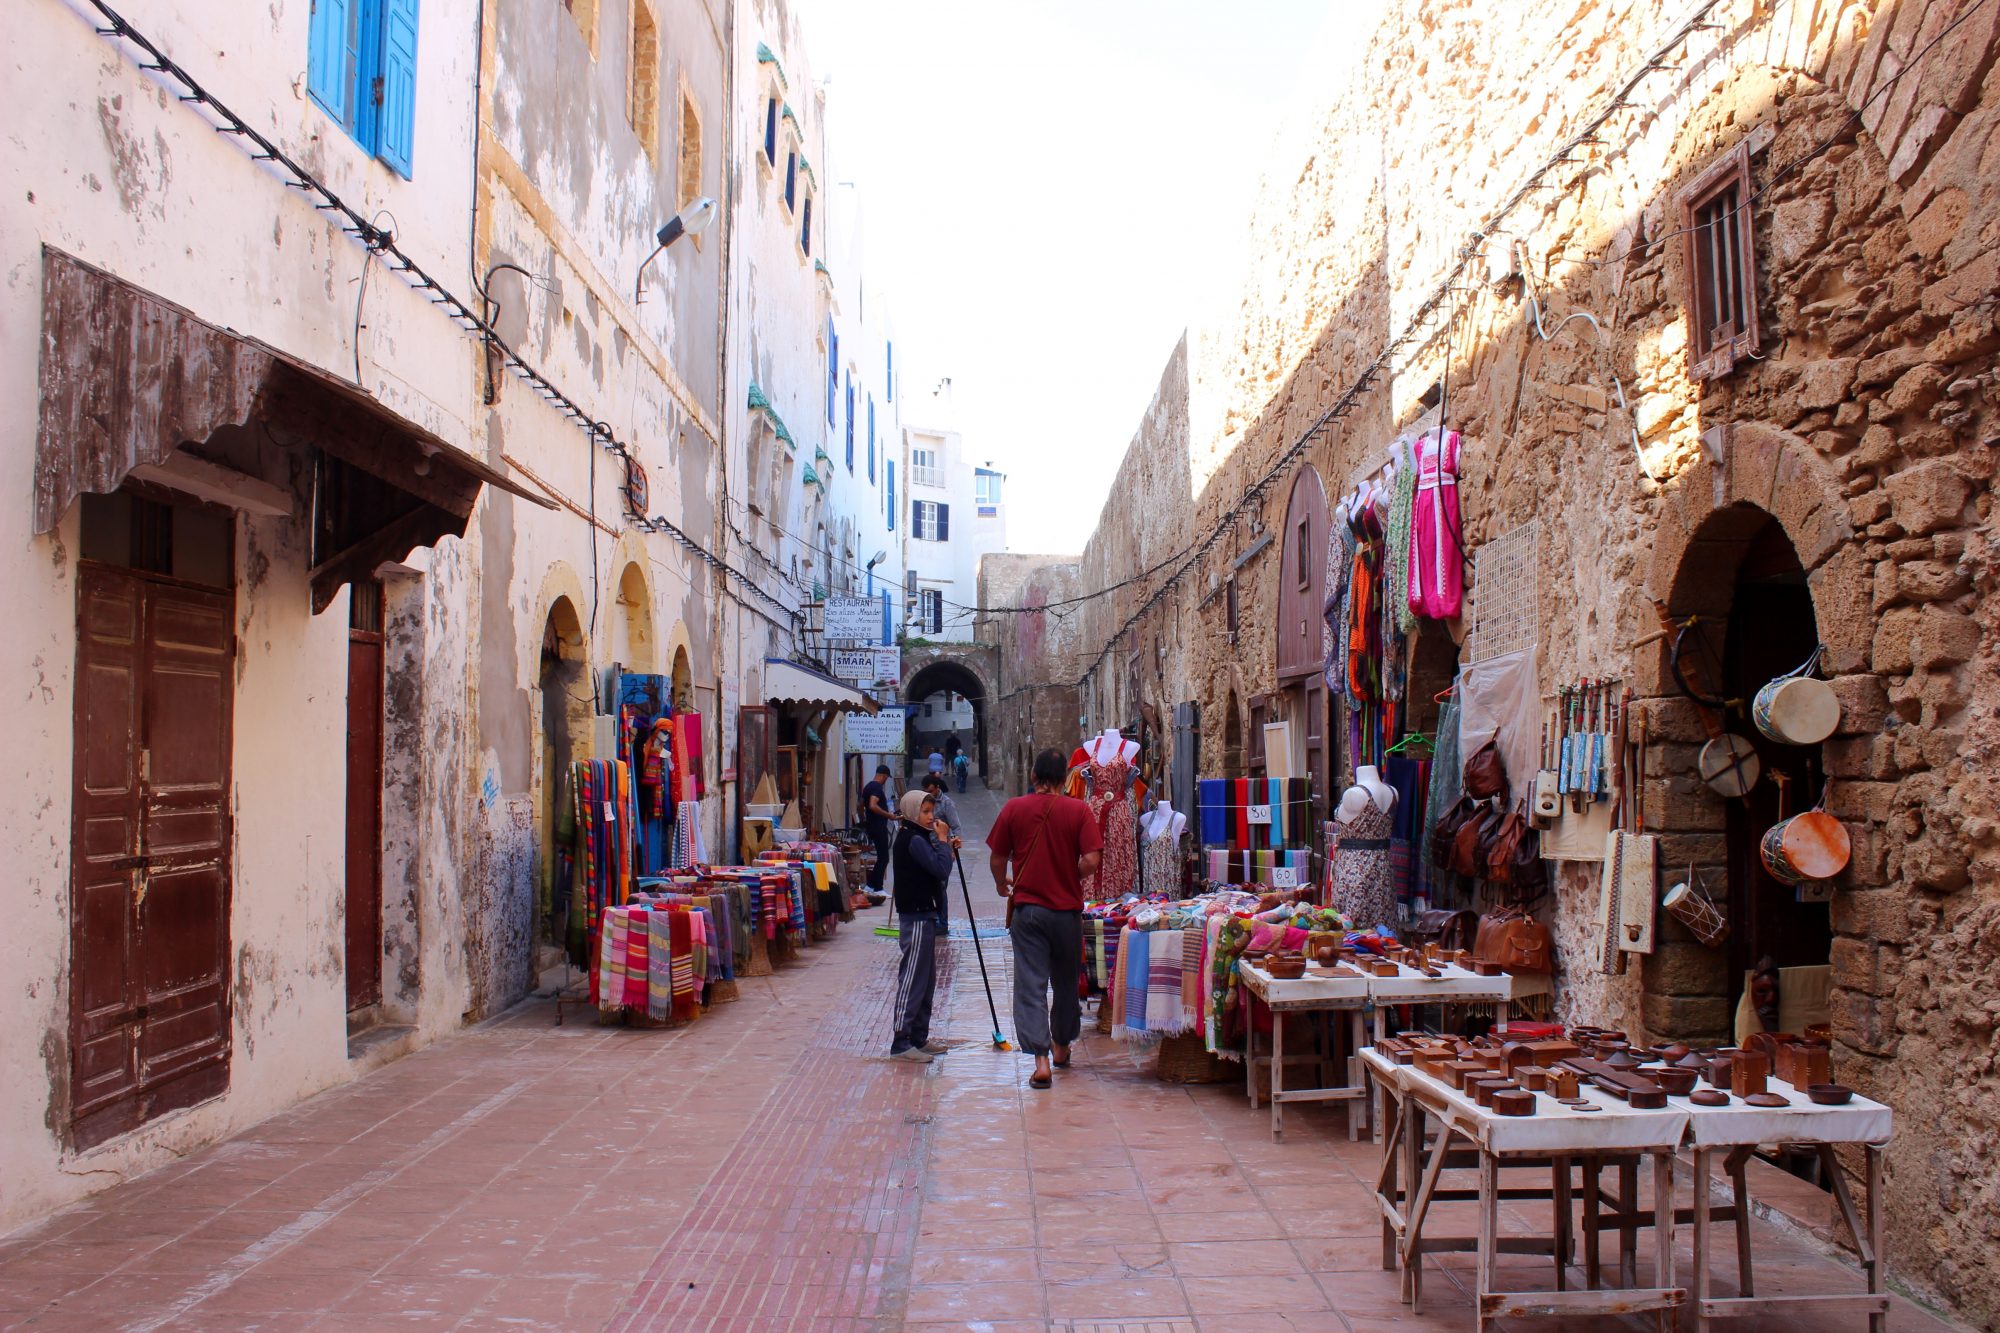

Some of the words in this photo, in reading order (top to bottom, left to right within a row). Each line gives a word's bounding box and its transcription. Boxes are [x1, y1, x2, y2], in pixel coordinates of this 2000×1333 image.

[829, 599, 872, 607] RESTAURANT
[837, 657, 872, 665] SMARA
[1252, 807, 1266, 818] 80
[1276, 869, 1290, 879] 60
